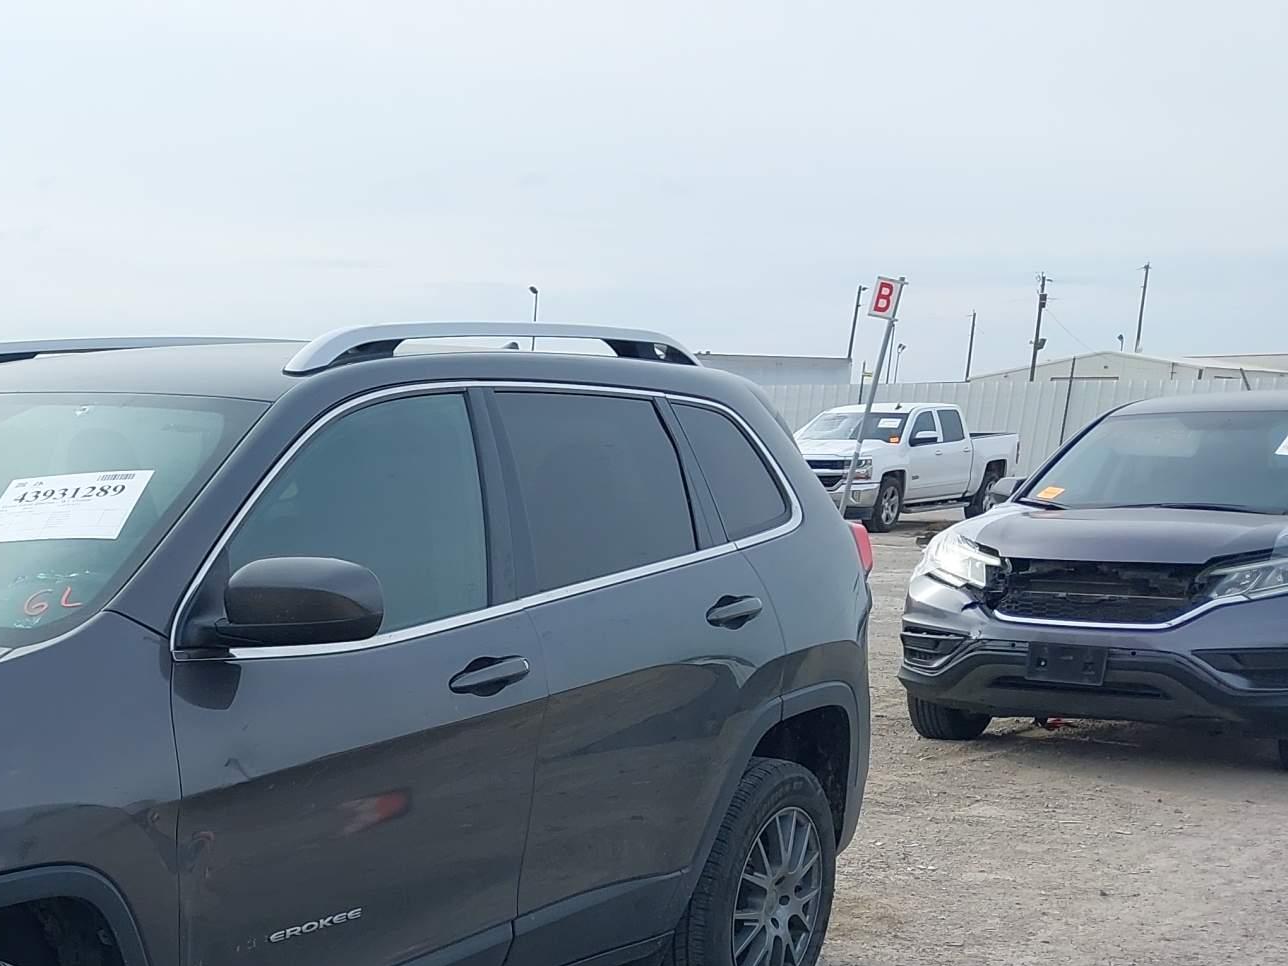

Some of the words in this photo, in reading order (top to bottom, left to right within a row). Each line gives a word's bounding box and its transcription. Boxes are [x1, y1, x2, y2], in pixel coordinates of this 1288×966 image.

[873, 282, 894, 313] B
[13, 484, 126, 504] 43931289
[269, 907, 363, 943] EROKEE
